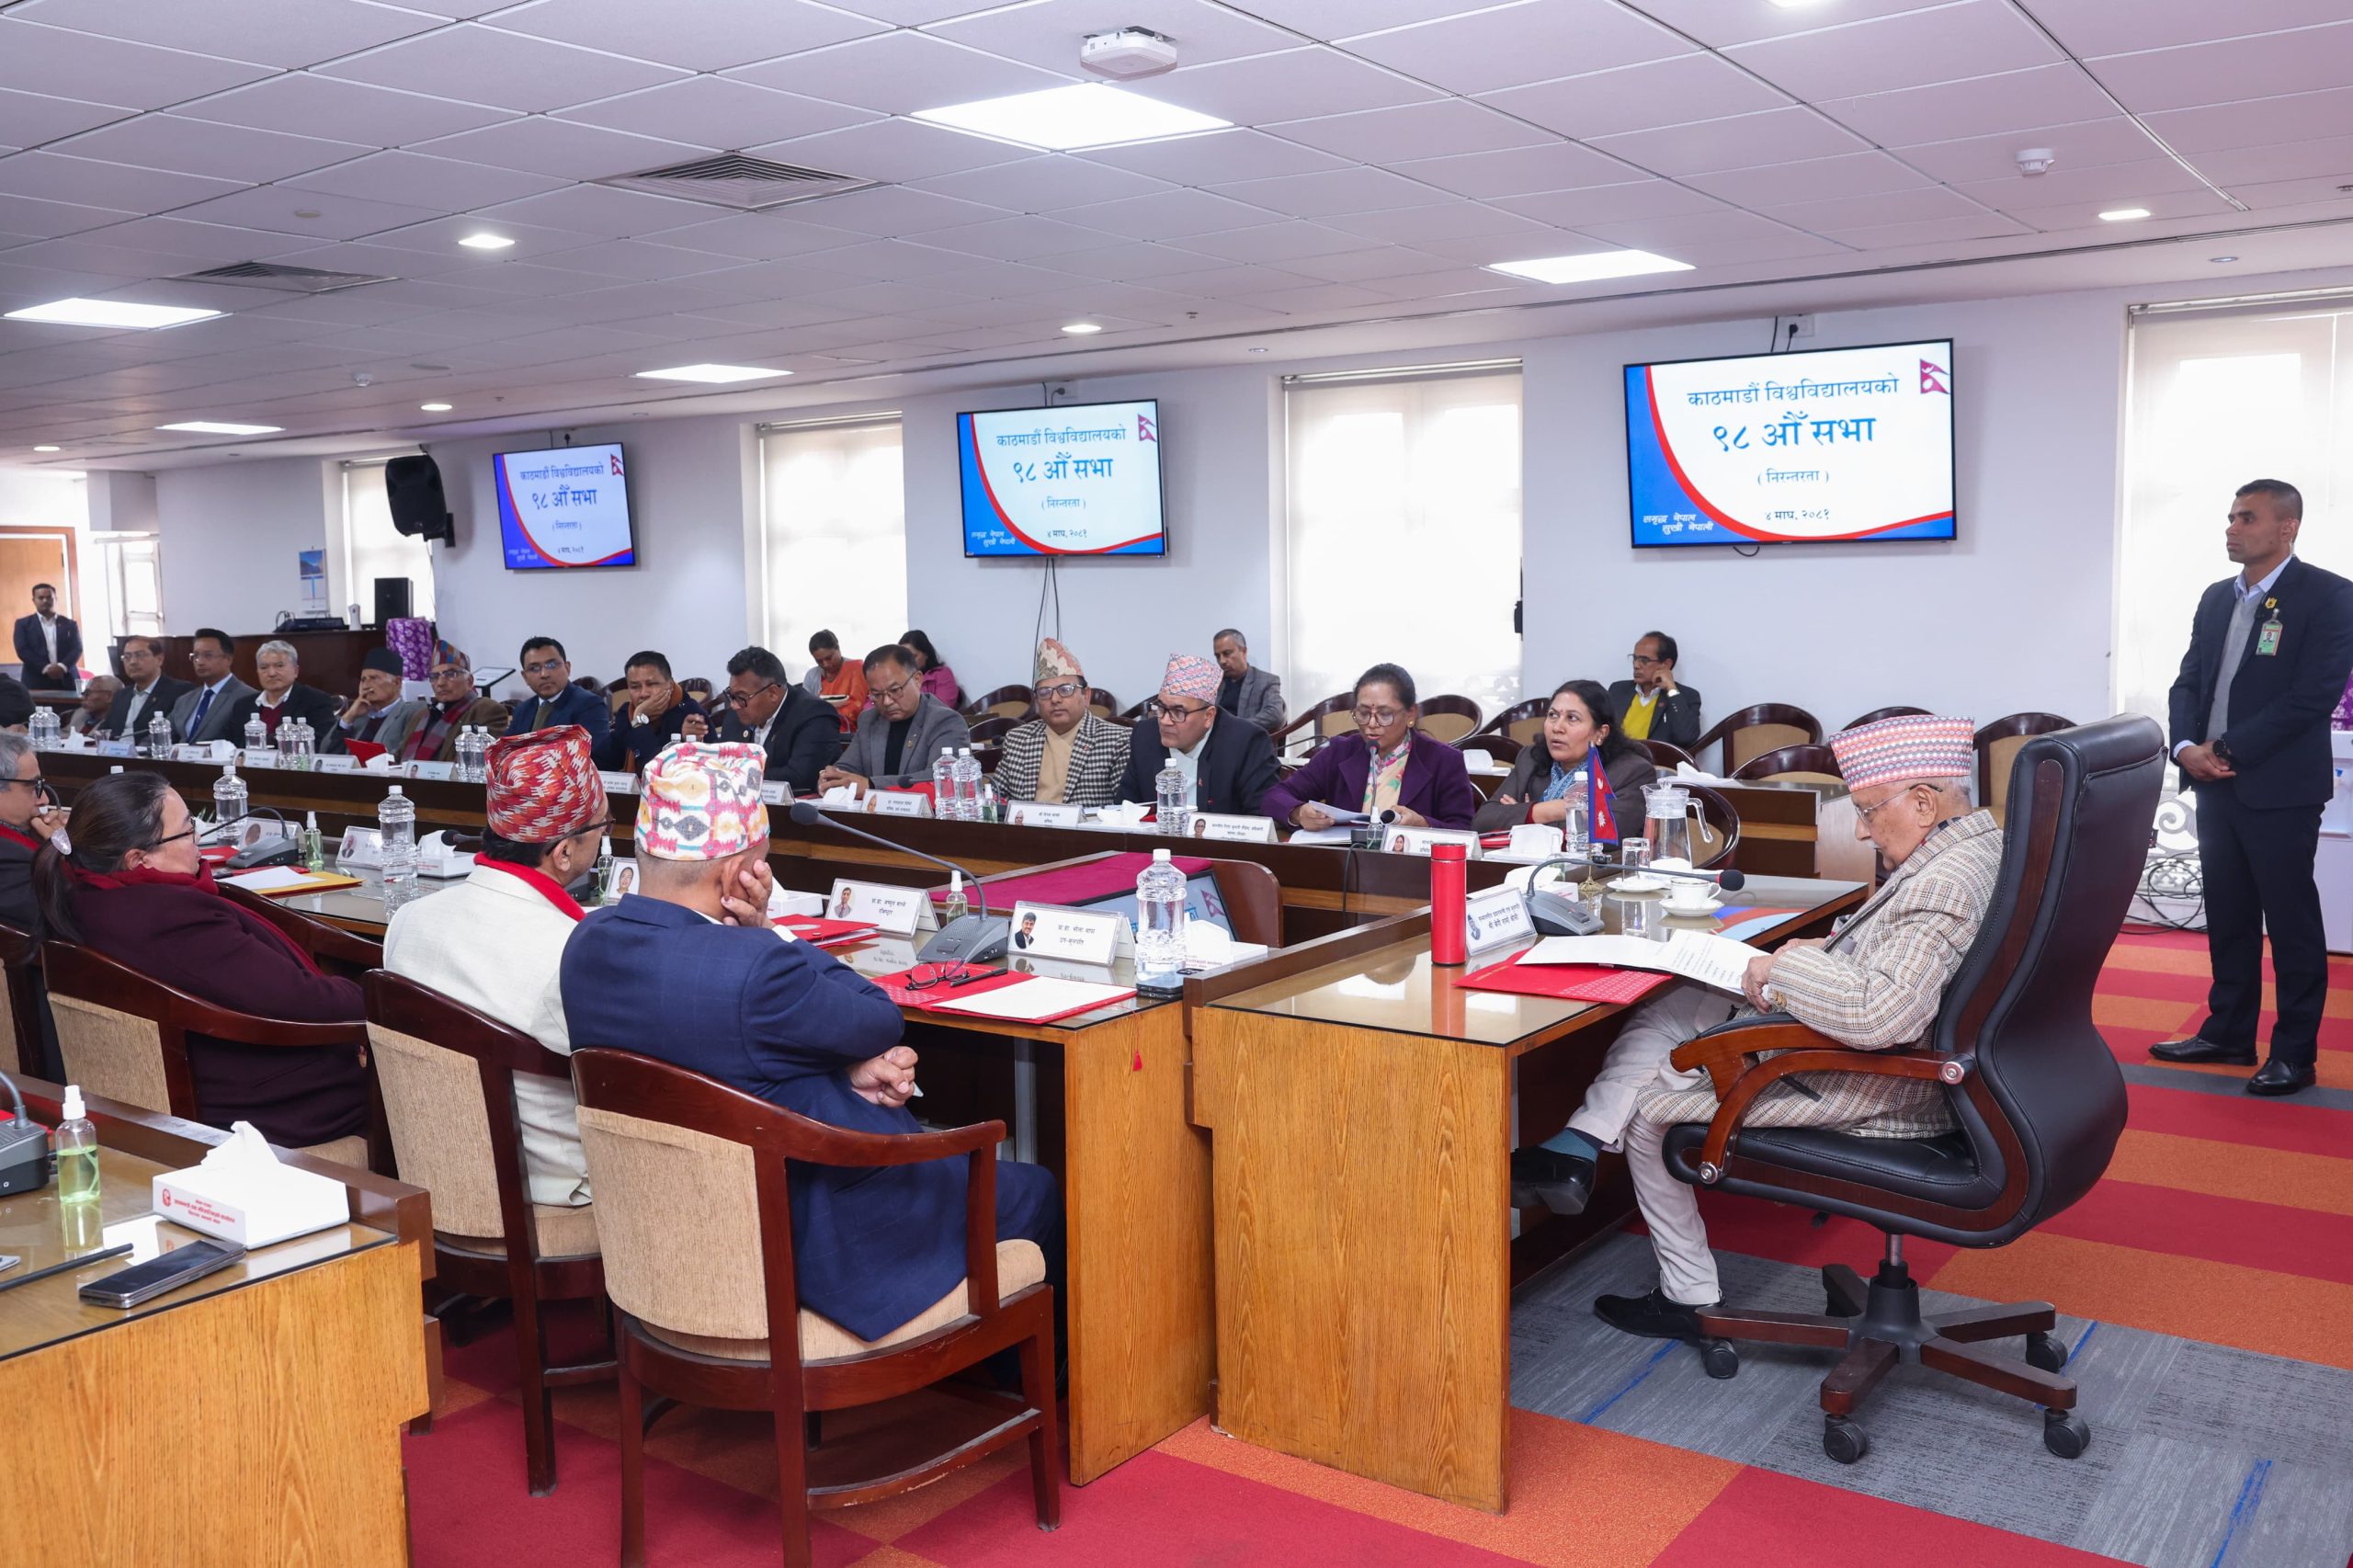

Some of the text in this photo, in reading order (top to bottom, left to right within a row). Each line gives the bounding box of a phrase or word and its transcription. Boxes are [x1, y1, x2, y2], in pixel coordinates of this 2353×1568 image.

[1764, 372, 1900, 401] विश्वविद्यालयको
[1044, 424, 1127, 444] विश्वविद्यालयको
[1713, 426, 1750, 452] ९८
[1810, 417, 1877, 446] सभा
[1013, 461, 1037, 483] ९८
[1073, 458, 1114, 478] सभा
[571, 489, 597, 506] सभा
